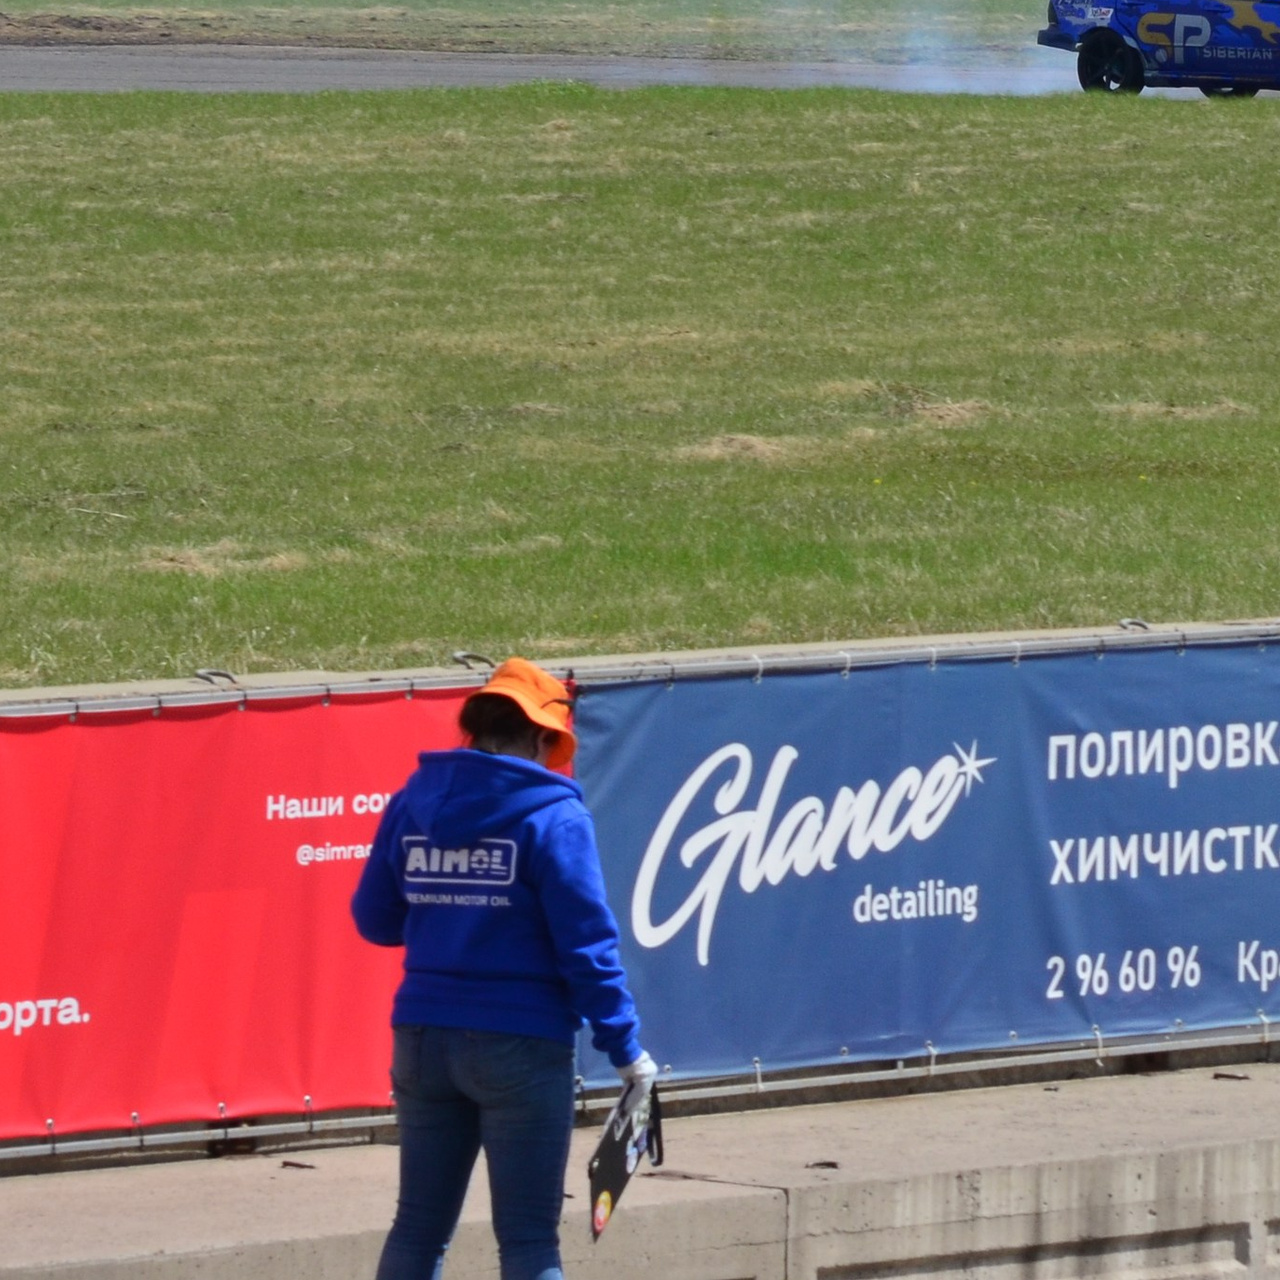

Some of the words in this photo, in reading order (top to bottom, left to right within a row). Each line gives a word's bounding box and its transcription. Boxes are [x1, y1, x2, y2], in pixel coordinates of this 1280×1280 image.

[1202, 47, 1273, 60] SIBERIAN
[266, 794, 344, 820] Наши
[405, 847, 508, 875] AIMOL
[631, 742, 966, 967] Glance
[454, 894, 488, 906] MOTOR
[490, 895, 511, 907] OIL
[853, 879, 978, 923] detailing
[1046, 956, 1065, 1000] 2
[1075, 952, 1109, 996] 96
[1118, 948, 1156, 993] 60
[1167, 945, 1201, 989] 96
